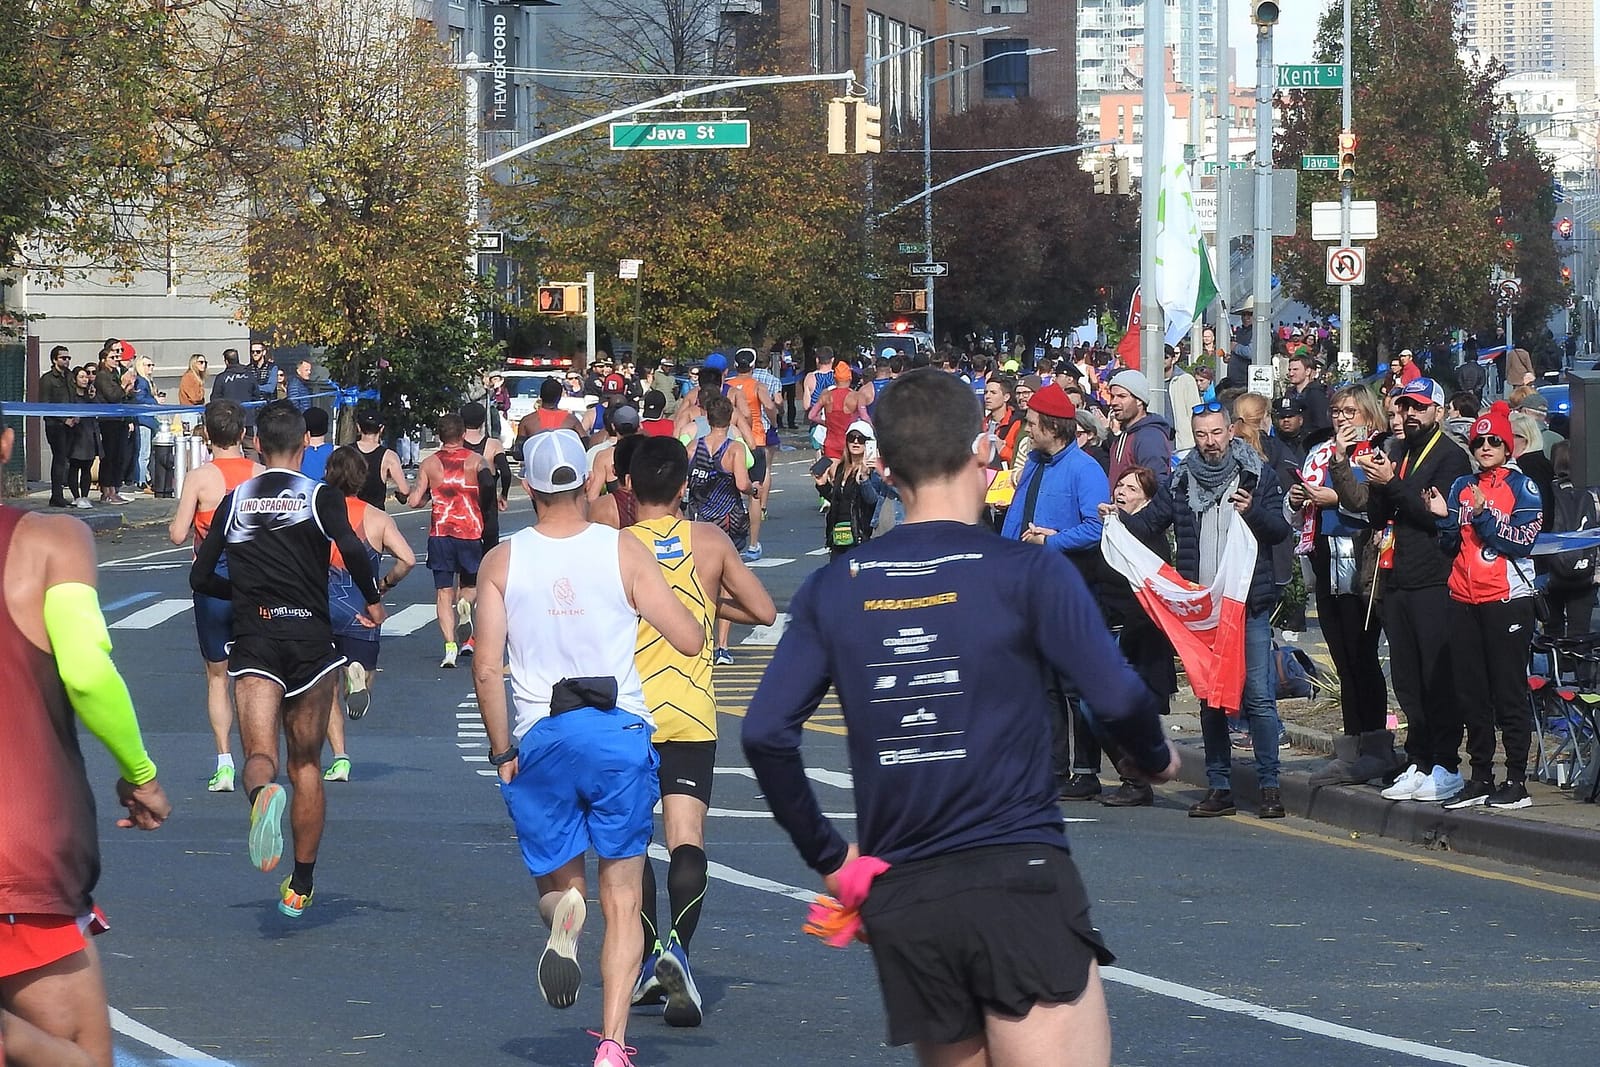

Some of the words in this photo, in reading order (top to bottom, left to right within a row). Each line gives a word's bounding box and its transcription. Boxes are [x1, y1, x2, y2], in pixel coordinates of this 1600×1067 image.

[1280, 67, 1320, 86] Kent
[1327, 66, 1337, 77] St
[646, 126, 686, 141] Java
[696, 125, 715, 140] St
[1306, 157, 1329, 168] Java
[240, 500, 258, 512] LINO
[260, 499, 302, 511] SPAGNOLI
[548, 608, 567, 616] TEAM
